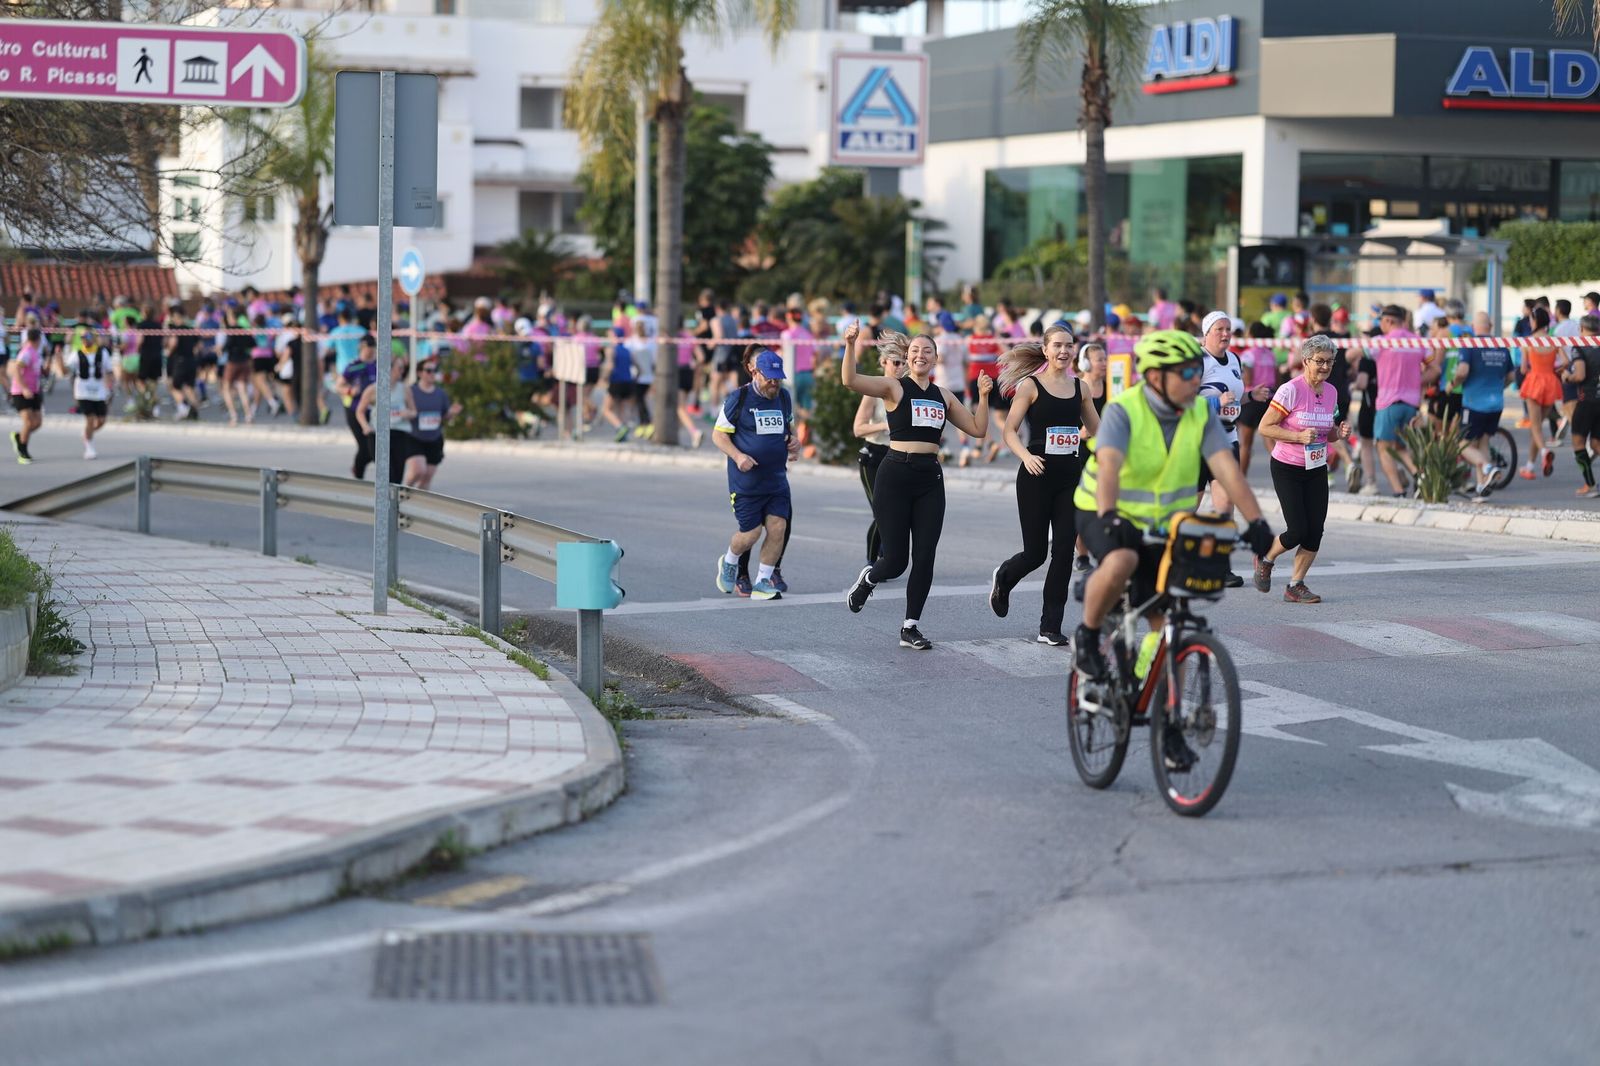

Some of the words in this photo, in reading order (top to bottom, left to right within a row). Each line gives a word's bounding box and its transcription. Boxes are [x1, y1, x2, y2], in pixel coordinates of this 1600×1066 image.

[32, 40, 108, 59] Cultural
[1143, 14, 1237, 80] ALDI
[20, 66, 37, 82] R.
[47, 67, 116, 85] Picasso
[1445, 46, 1600, 99] ALD
[845, 132, 909, 150] ALDI
[757, 416, 783, 427] 1536
[914, 406, 944, 420] 1135
[1049, 434, 1079, 446] 1643
[1310, 449, 1325, 461] 682
